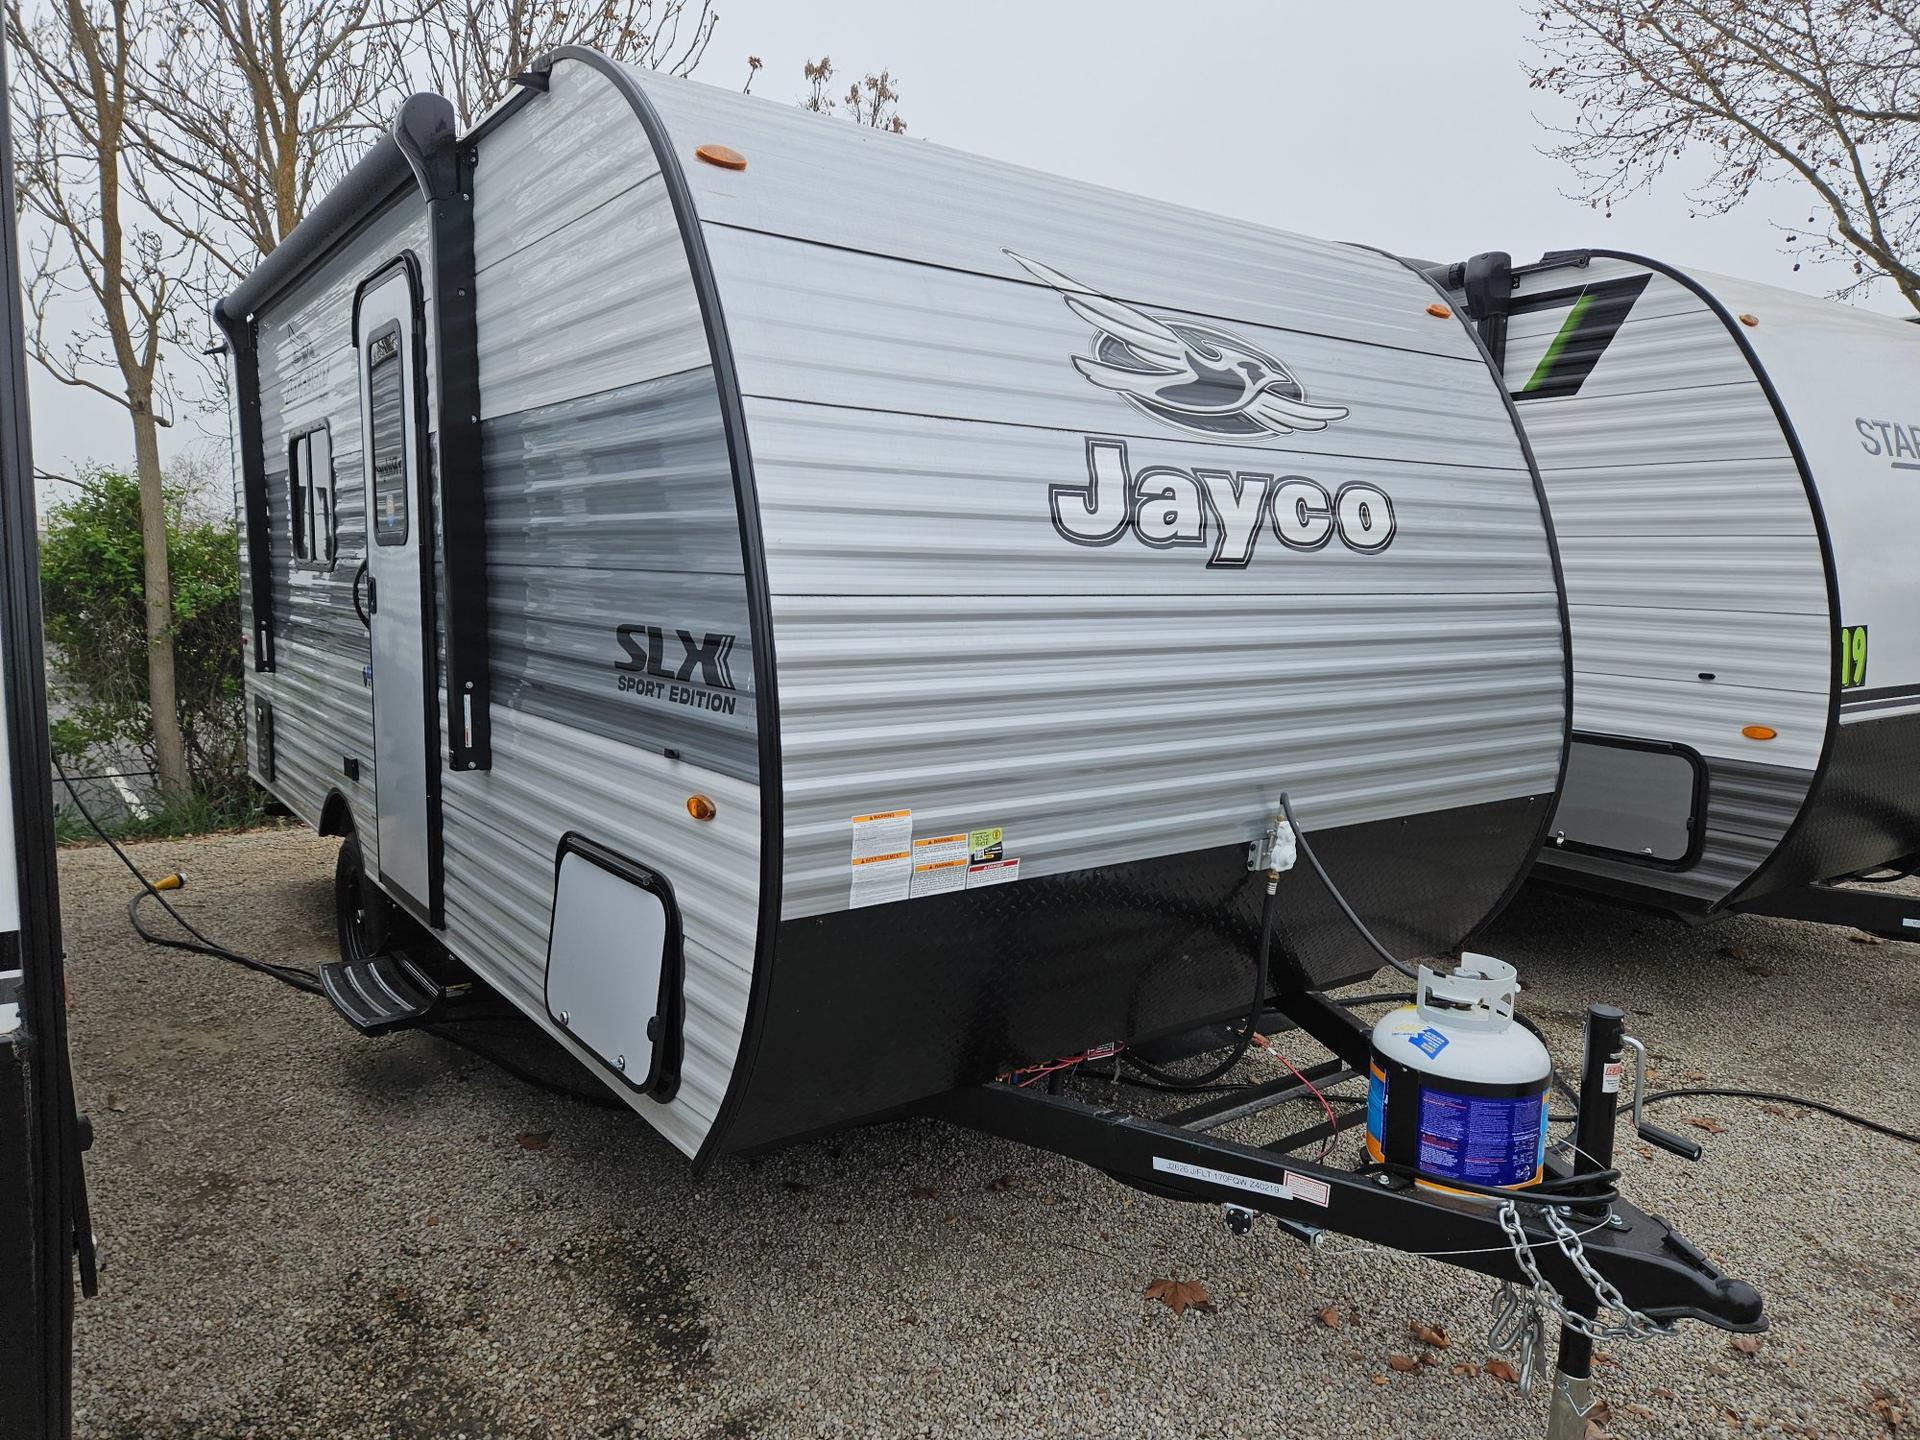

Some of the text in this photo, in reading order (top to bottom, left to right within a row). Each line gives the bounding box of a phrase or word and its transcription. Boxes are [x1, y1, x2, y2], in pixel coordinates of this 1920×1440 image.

[1049, 436, 1397, 569] Jayco
[615, 624, 736, 690] SLX
[1842, 626, 1867, 687] 19
[617, 675, 736, 715] SPORT EDITION
[934, 836, 953, 844] WARNING
